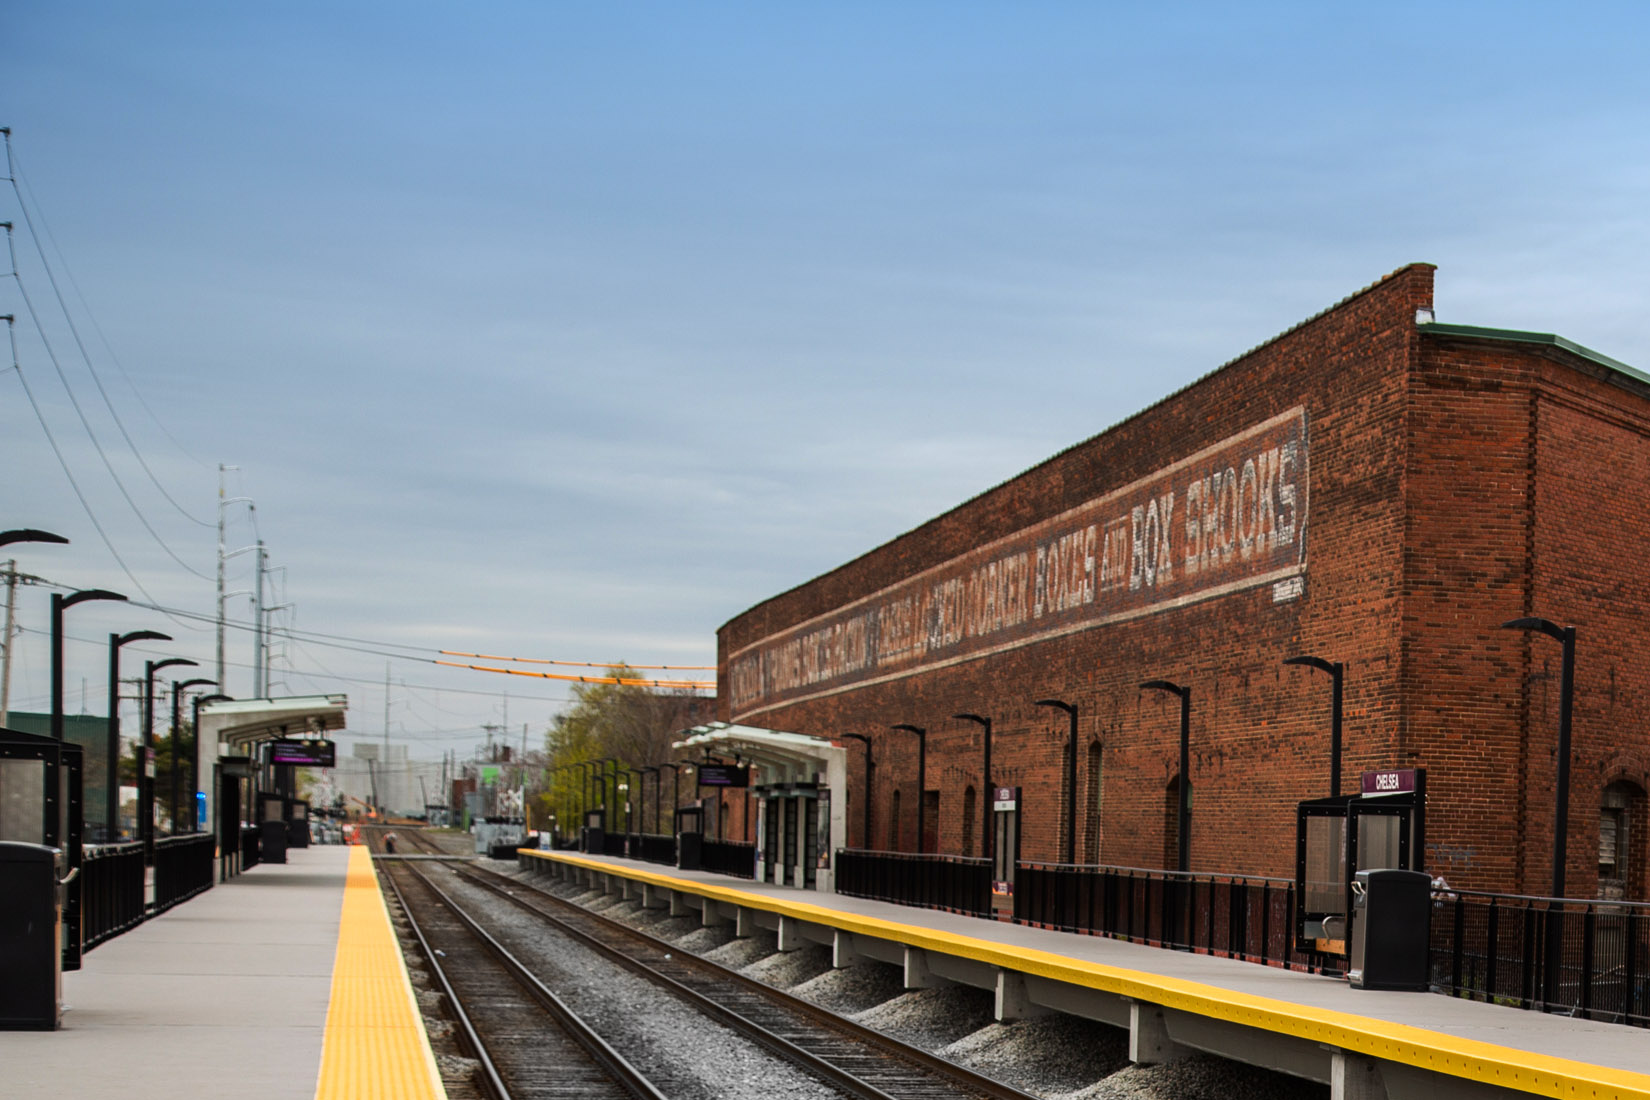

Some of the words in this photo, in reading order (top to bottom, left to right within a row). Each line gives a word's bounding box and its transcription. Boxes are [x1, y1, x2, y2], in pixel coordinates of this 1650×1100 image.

[1033, 525, 1096, 619] BOXES
[1102, 526, 1127, 582] AND
[1129, 492, 1174, 591] BOX
[1185, 440, 1298, 574] SHOOKS
[1375, 773, 1399, 790] CHELSEA
